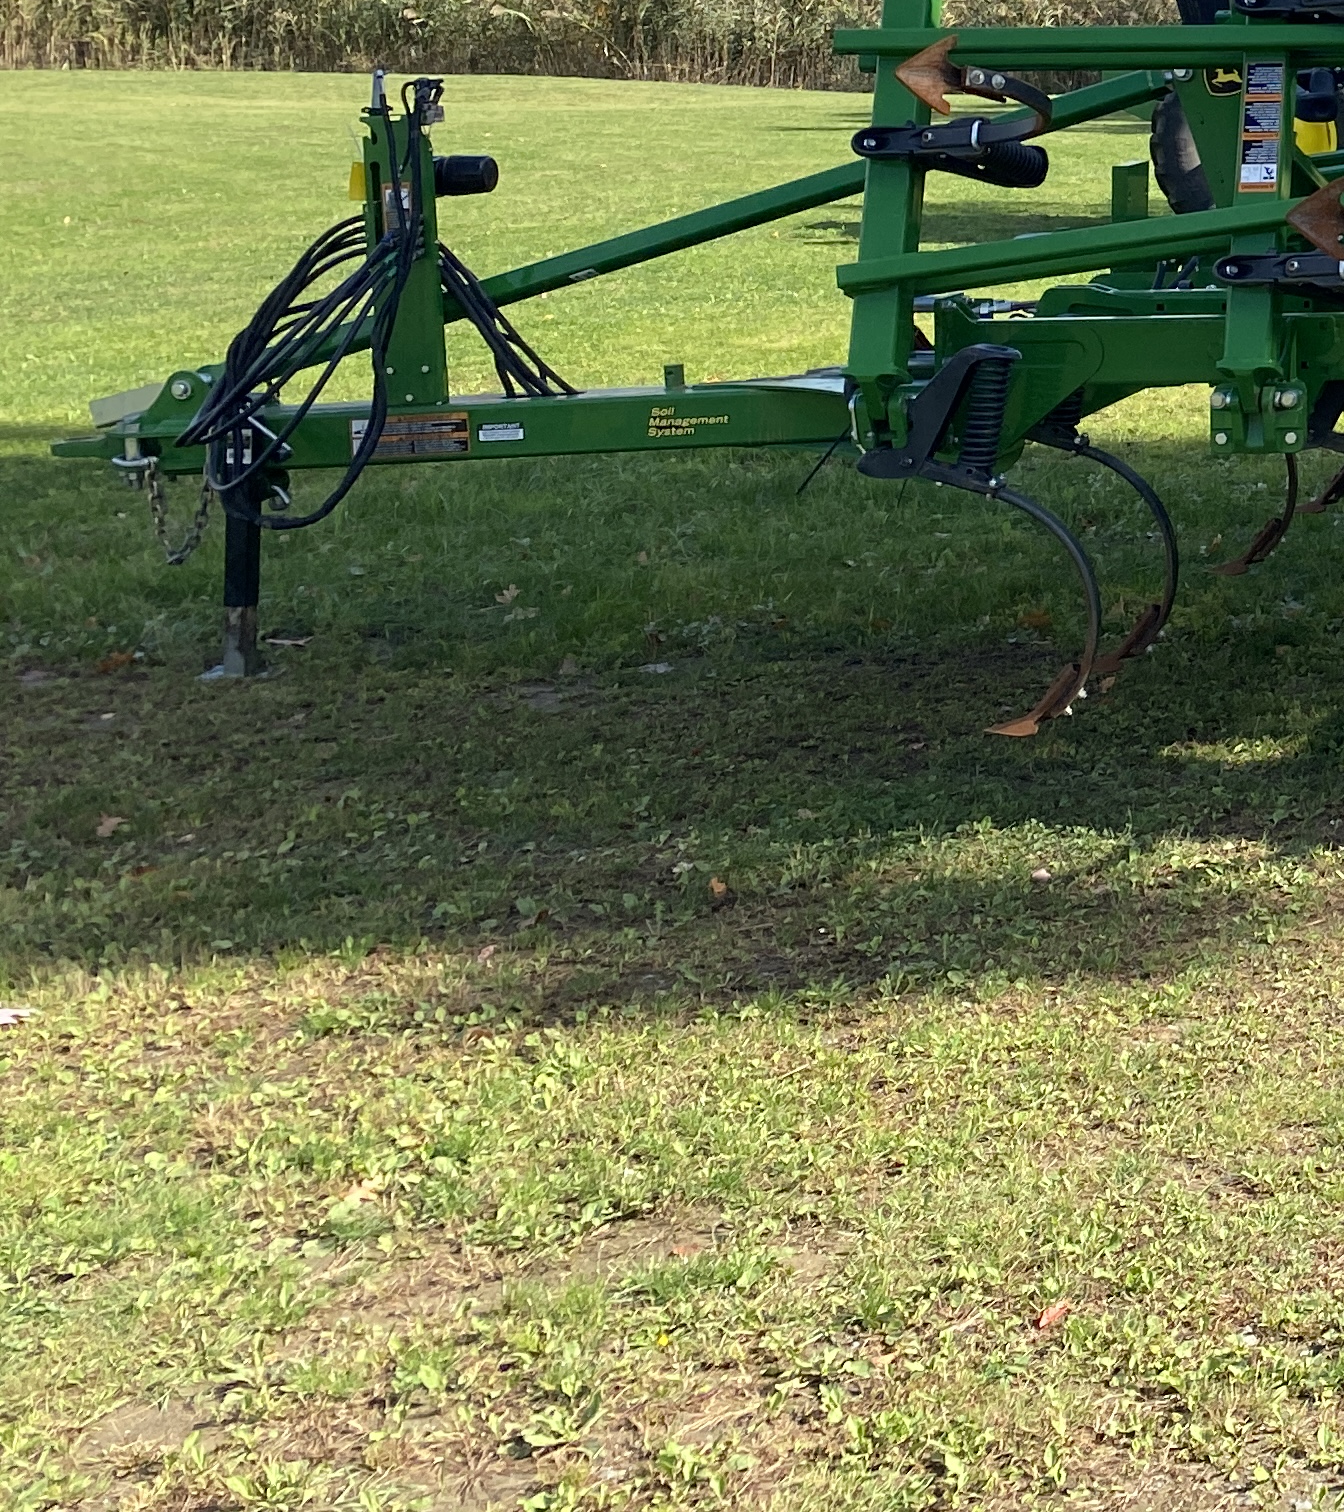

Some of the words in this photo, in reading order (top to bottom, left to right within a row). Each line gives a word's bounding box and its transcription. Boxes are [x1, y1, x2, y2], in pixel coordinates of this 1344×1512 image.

[651, 406, 675, 417] Soil
[648, 415, 729, 427] Management
[647, 427, 695, 438] System
